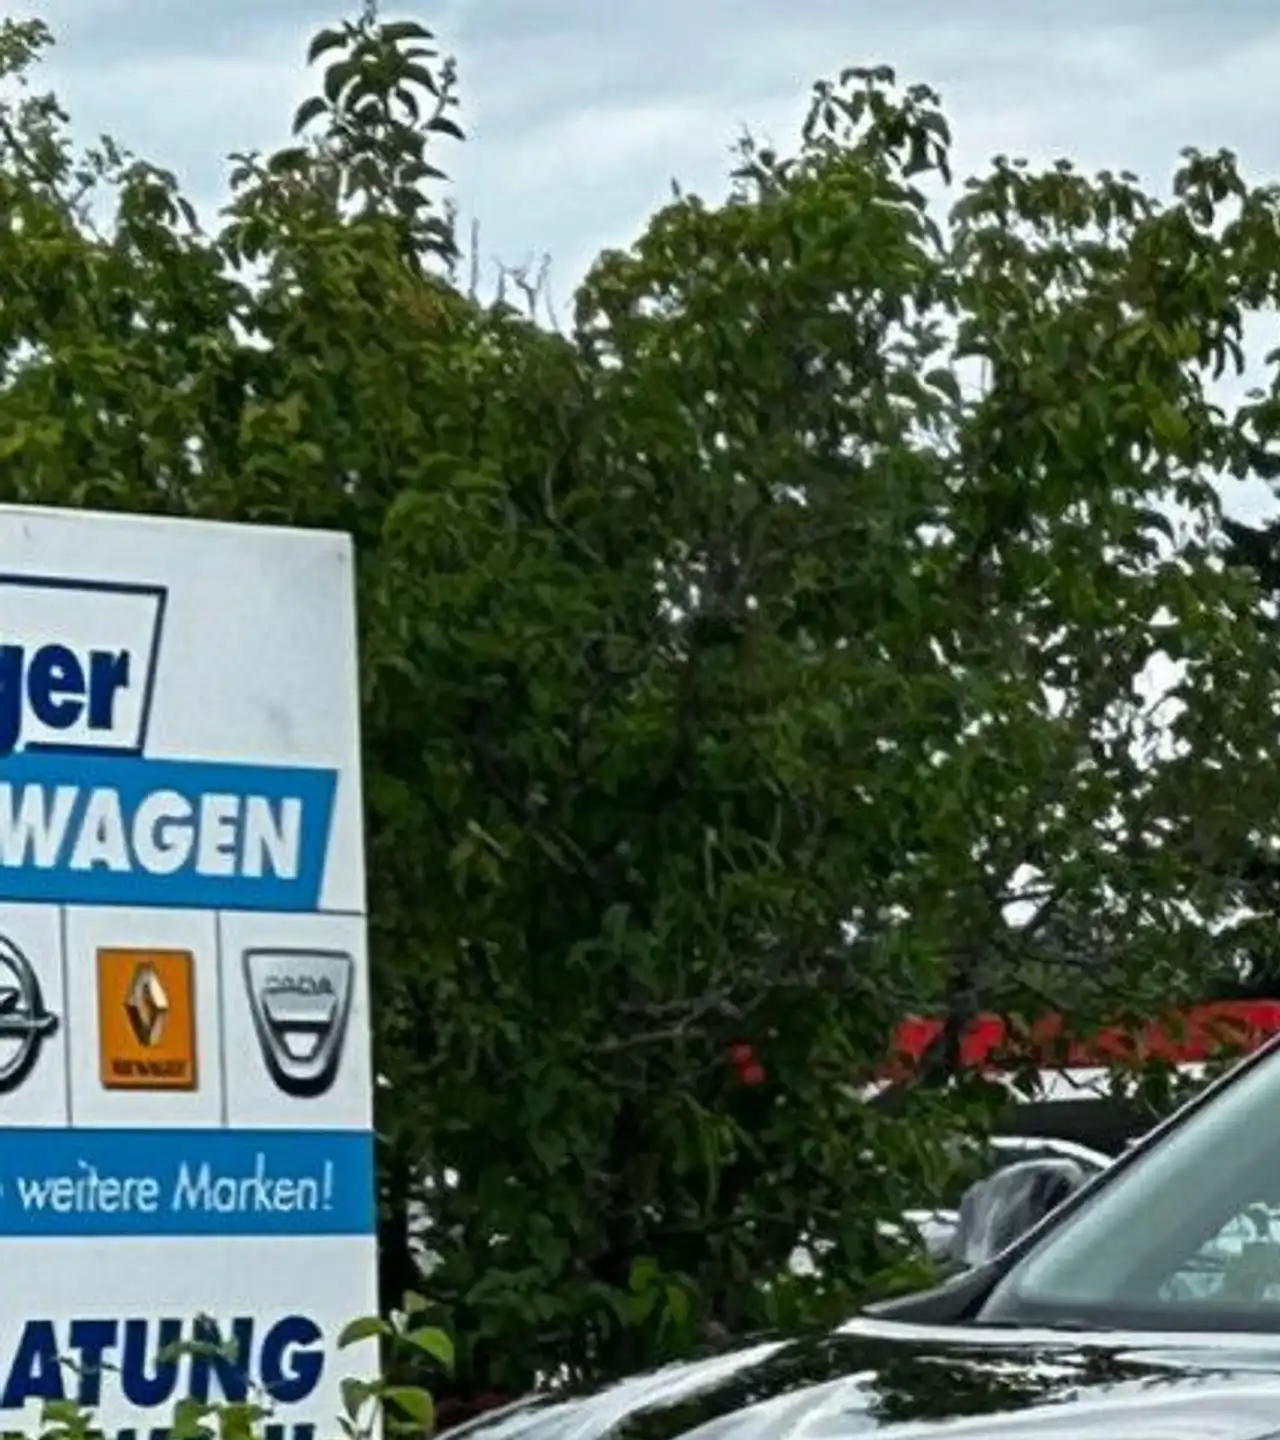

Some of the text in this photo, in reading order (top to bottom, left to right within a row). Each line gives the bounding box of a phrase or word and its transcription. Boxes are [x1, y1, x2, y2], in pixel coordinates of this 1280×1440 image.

[0, 781, 302, 880] WAGEN
[18, 1151, 334, 1212] weitere Marken!
[0, 1315, 325, 1408] ATUNG
